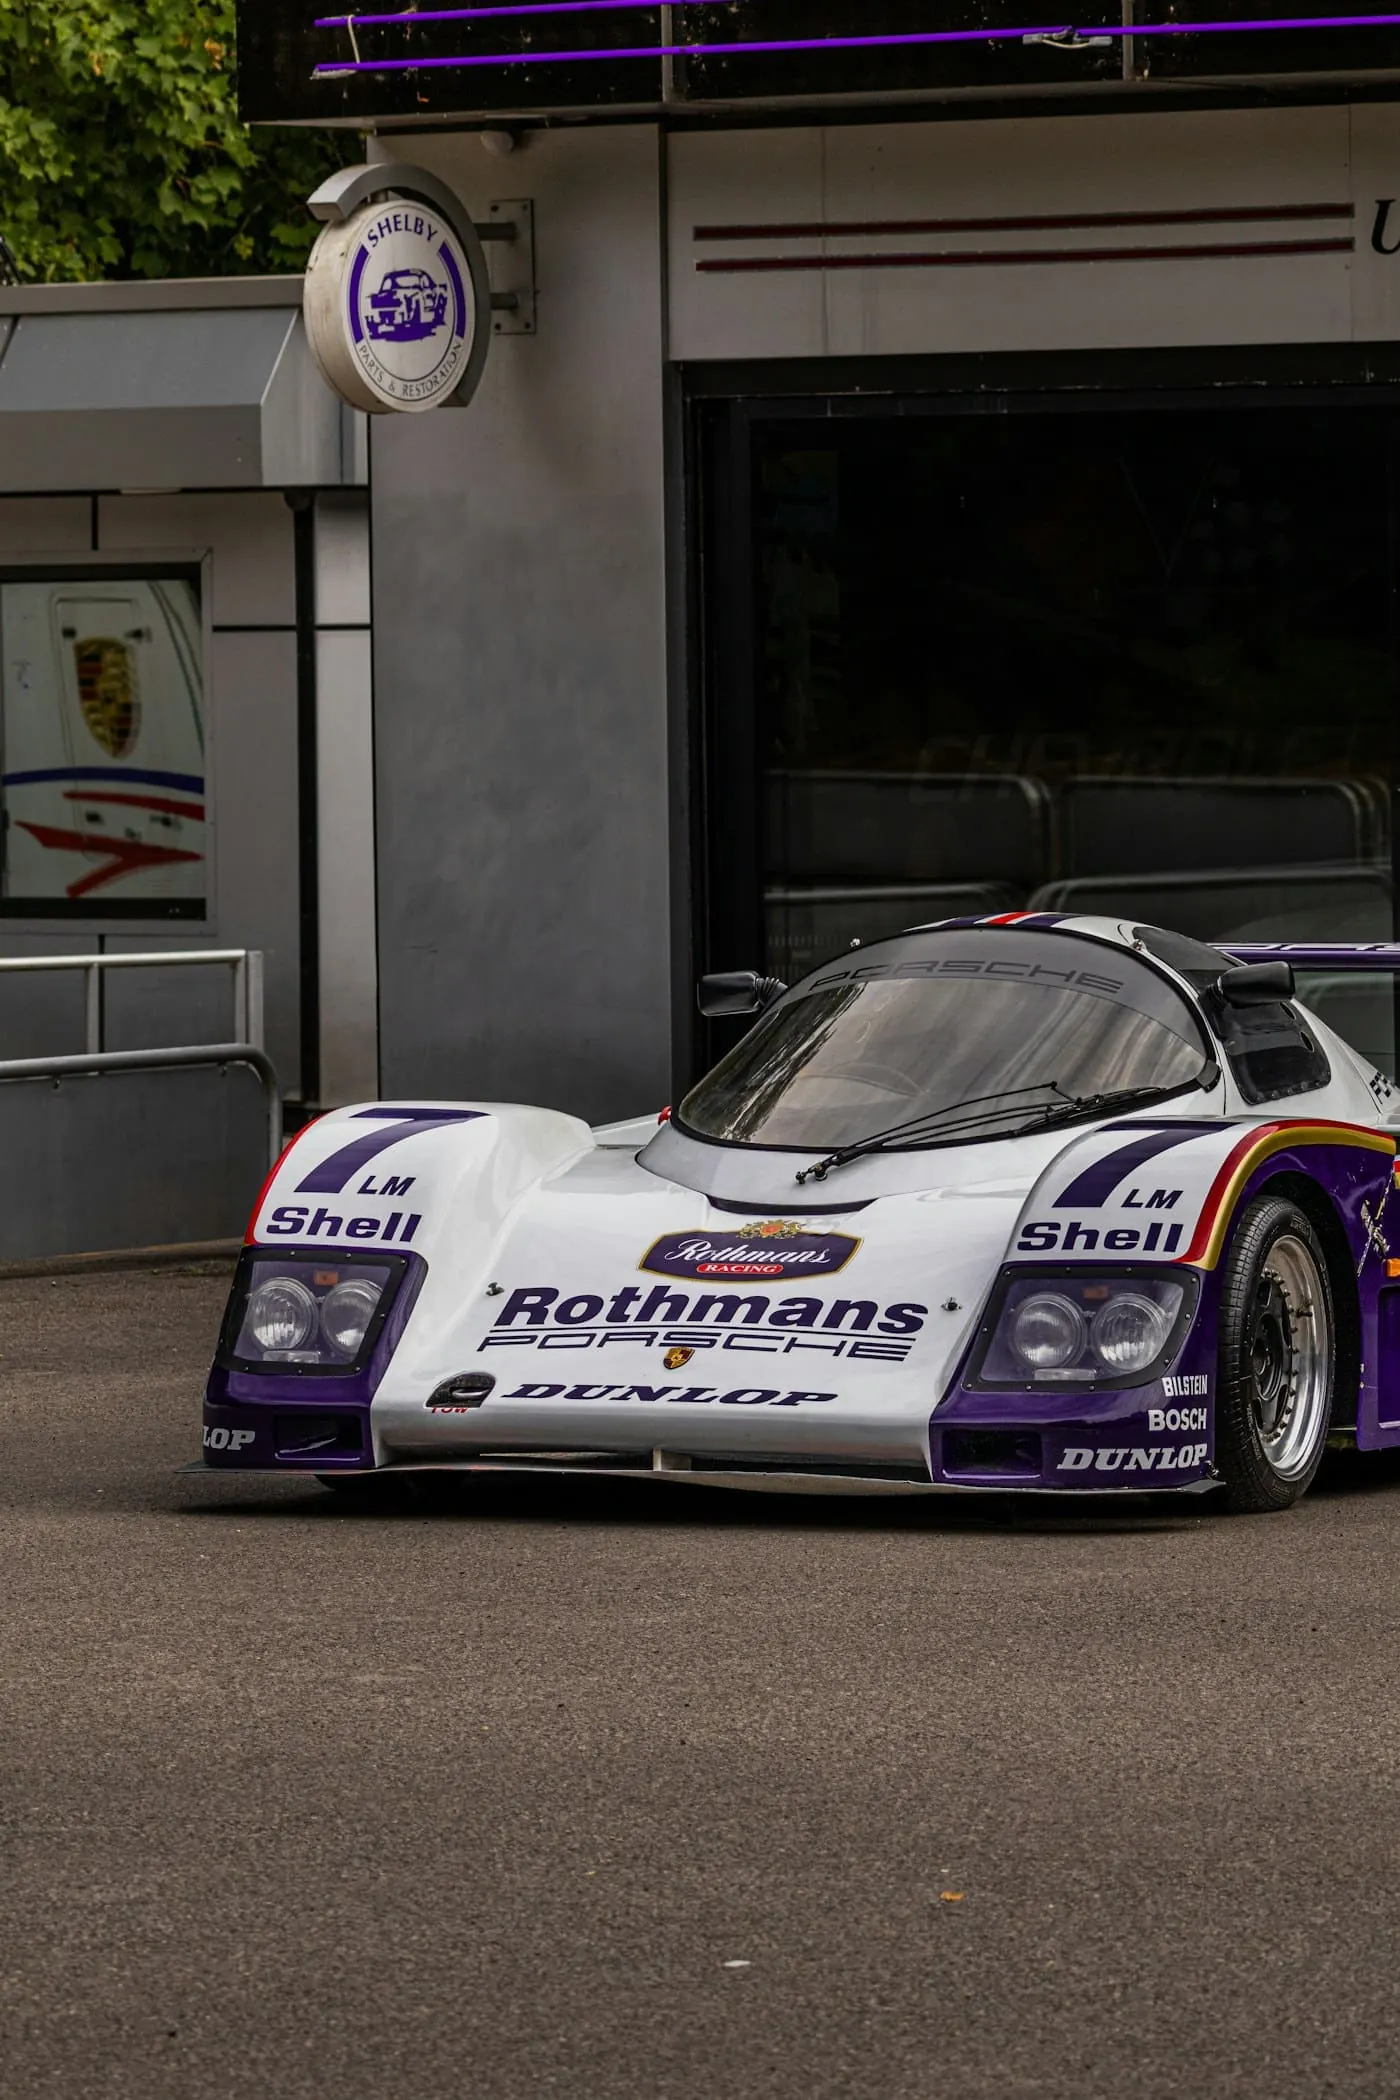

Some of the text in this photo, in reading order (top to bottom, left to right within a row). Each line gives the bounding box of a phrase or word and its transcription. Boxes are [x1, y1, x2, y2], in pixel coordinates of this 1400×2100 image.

[367, 213, 438, 247] SHELBY
[359, 342, 463, 397] PARTS & RESTORATION
[808, 960, 1124, 994] PORSCHE
[294, 1107, 492, 1193] 7
[1051, 1119, 1243, 1208] 7
[357, 1175, 417, 1197] LM
[1120, 1188, 1184, 1209] LM
[266, 1206, 422, 1243] Shell
[1016, 1221, 1184, 1253] Shell
[664, 1238, 831, 1264] Rothmans
[705, 1264, 776, 1273] RACING
[493, 1285, 929, 1335] Rothmans
[476, 1331, 917, 1362] PORSCHE
[501, 1383, 838, 1407] DUNLOP
[1161, 1374, 1208, 1397] BILSTEIN
[1147, 1407, 1208, 1431] BOSCH
[1056, 1443, 1208, 1470] DUNLOP
